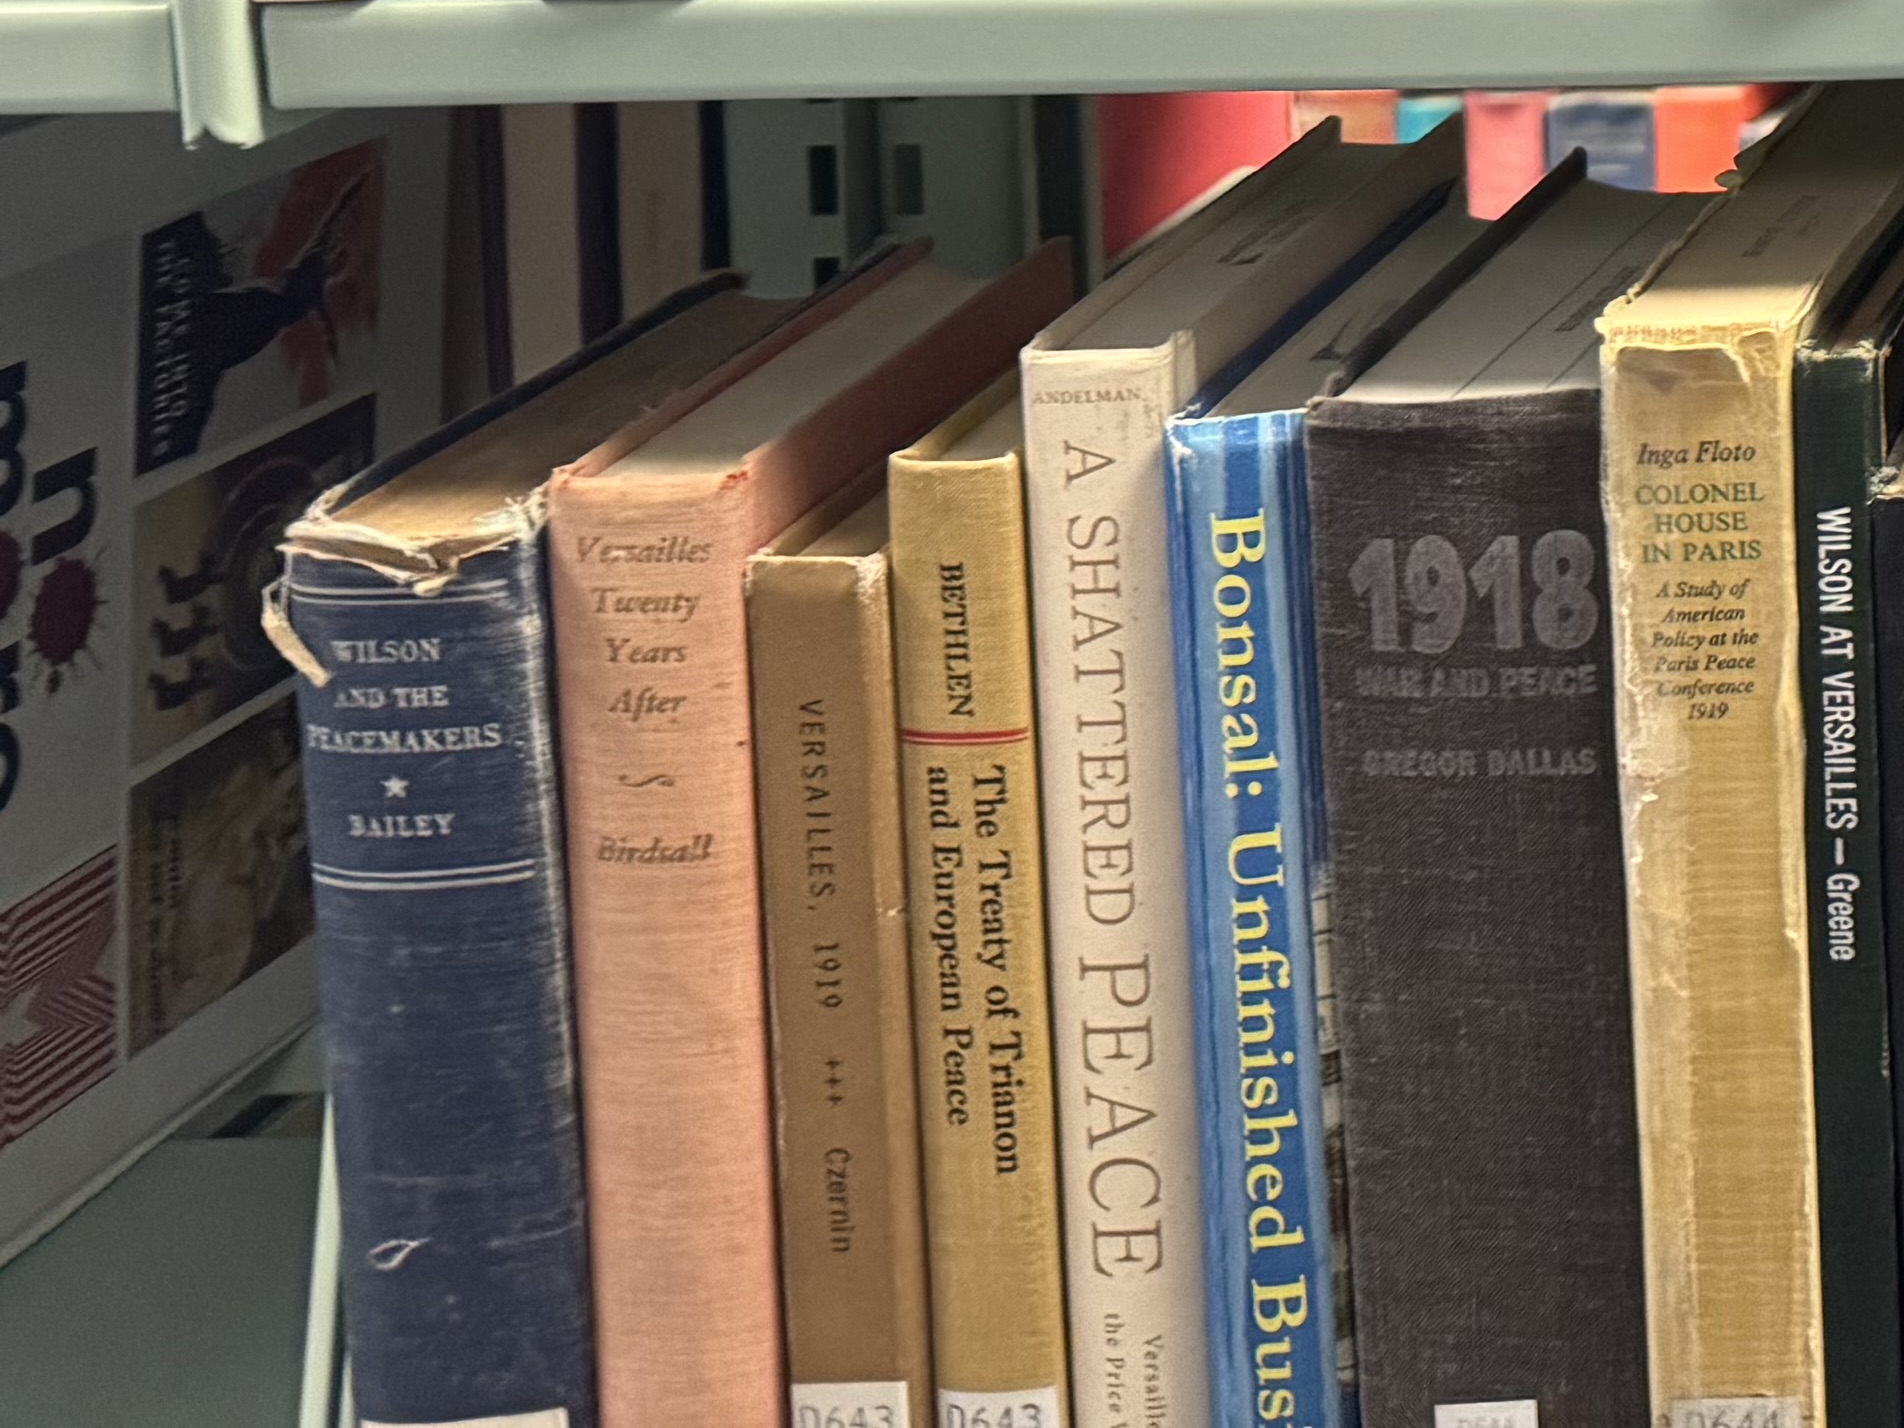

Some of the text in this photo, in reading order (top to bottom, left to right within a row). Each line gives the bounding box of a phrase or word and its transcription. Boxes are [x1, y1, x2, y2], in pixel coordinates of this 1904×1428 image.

[1636, 482, 1765, 509] COLONEL
[1655, 510, 1747, 536] HOUSE
[604, 639, 687, 665] Years
[938, 563, 975, 718] BETHLEN
[1350, 528, 1599, 653] 1918
[1816, 507, 1861, 962] WILSON AT VERSAILLES Greene
[1063, 441, 1164, 1278] A SHATTERED PEACE
[1210, 510, 1303, 1252] Bonsal: Unfinished
[972, 764, 1025, 1176] The Treaty of Trianon
